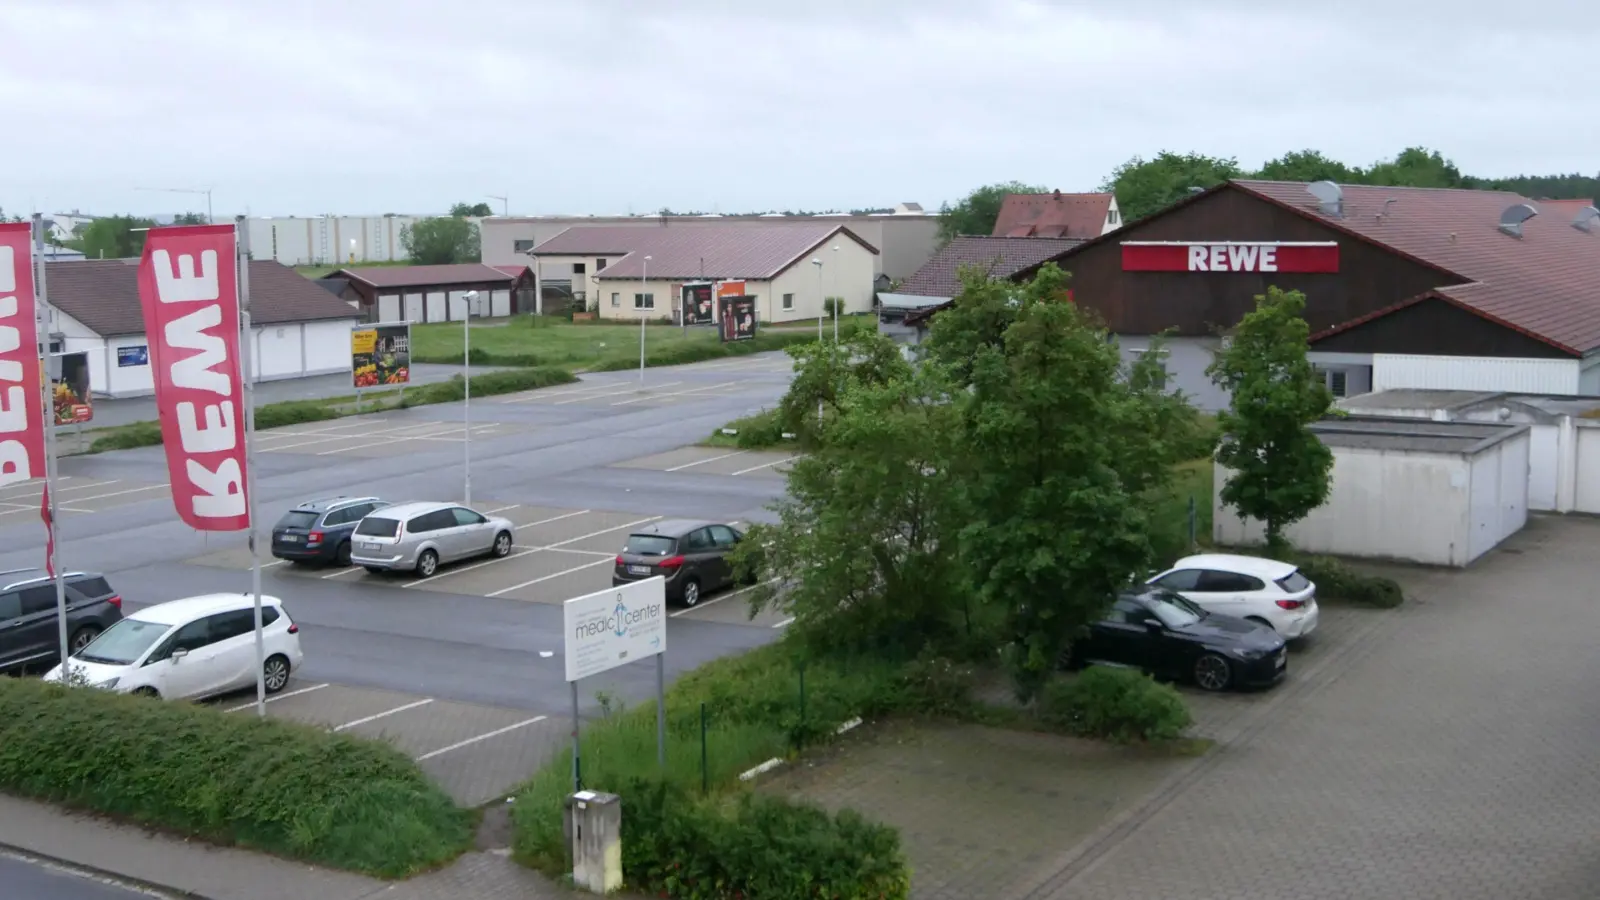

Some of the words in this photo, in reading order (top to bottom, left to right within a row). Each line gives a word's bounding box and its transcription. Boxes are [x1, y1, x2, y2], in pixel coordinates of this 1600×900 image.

[1188, 246, 1278, 271] REWE
[575, 615, 615, 640] medic
[624, 603, 661, 625] center
